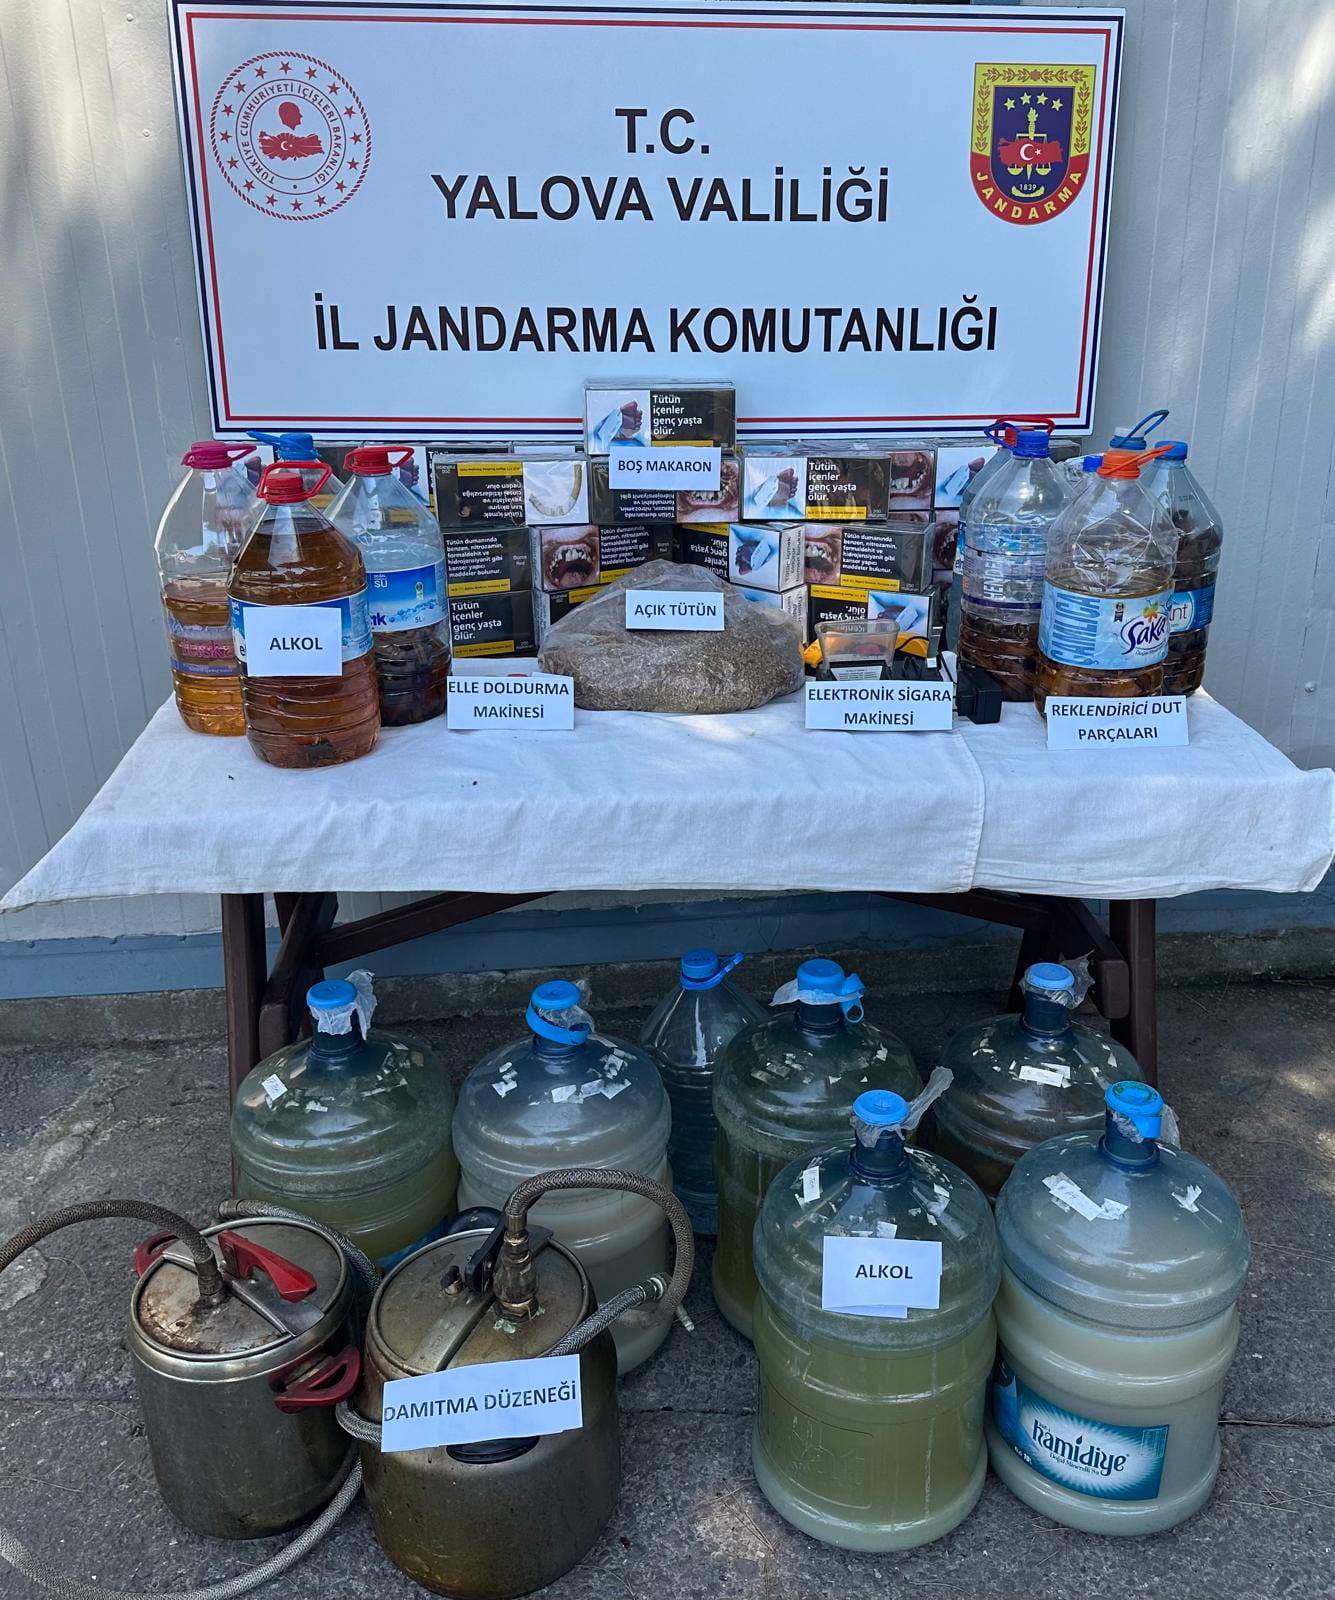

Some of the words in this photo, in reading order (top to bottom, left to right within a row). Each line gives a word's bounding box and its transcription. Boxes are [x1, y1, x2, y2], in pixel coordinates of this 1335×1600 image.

[240, 82, 294, 136] CUMHURİYETİ
[297, 84, 338, 123] İÇİŞLERİ
[616, 108, 709, 154] T.C.
[315, 126, 342, 185] BAKANLIĞI
[242, 141, 275, 185] TÜRKİYE
[431, 174, 653, 222] YALOVA
[668, 166, 888, 222] VALİLİĞİ
[1019, 183, 1037, 191] 1839
[976, 172, 1082, 219] JANDARMA
[314, 292, 360, 351] İL
[373, 304, 655, 353] JANDARMA
[670, 294, 998, 353] KOMUTANLIĞI
[652, 394, 680, 404] Tütün
[653, 405, 684, 416] içenler
[653, 417, 676, 427] genç
[677, 416, 702, 427] yaşta
[618, 460, 643, 474] BOŞ
[646, 461, 712, 472] MAKARON
[809, 462, 837, 471] Tütün
[809, 472, 840, 483] içenler
[808, 483, 831, 493] genç
[832, 482, 857, 493] yaşta
[690, 543, 710, 554] yaşta
[710, 546, 728, 556] genç
[704, 556, 728, 567] içenler
[451, 601, 479, 611] Tütün
[635, 604, 666, 620] AÇIK
[669, 602, 716, 617] TÜTÜN
[452, 611, 484, 622] içenler
[453, 622, 476, 632] genç
[477, 619, 502, 630] yaşta
[1121, 616, 1166, 655] Saka
[270, 637, 323, 650] ALKOL
[448, 681, 479, 693] ELLE
[484, 682, 569, 695] DOLDURMA
[808, 686, 894, 701] ELEKTRONİK
[898, 687, 952, 701] SİGARA
[474, 704, 544, 718] MAKİNESİ
[1052, 700, 1148, 717] REKLENDİRİCİ
[1152, 701, 1182, 714] DUT
[844, 710, 914, 725] MAKİNESİ
[1079, 727, 1158, 742] PARÇALARI
[855, 1264, 913, 1279] ALKOL
[383, 1396, 479, 1422] DAMITMA
[485, 1380, 576, 1410] DÜZENEĞİ
[1032, 1418, 1126, 1477] hamidiye
